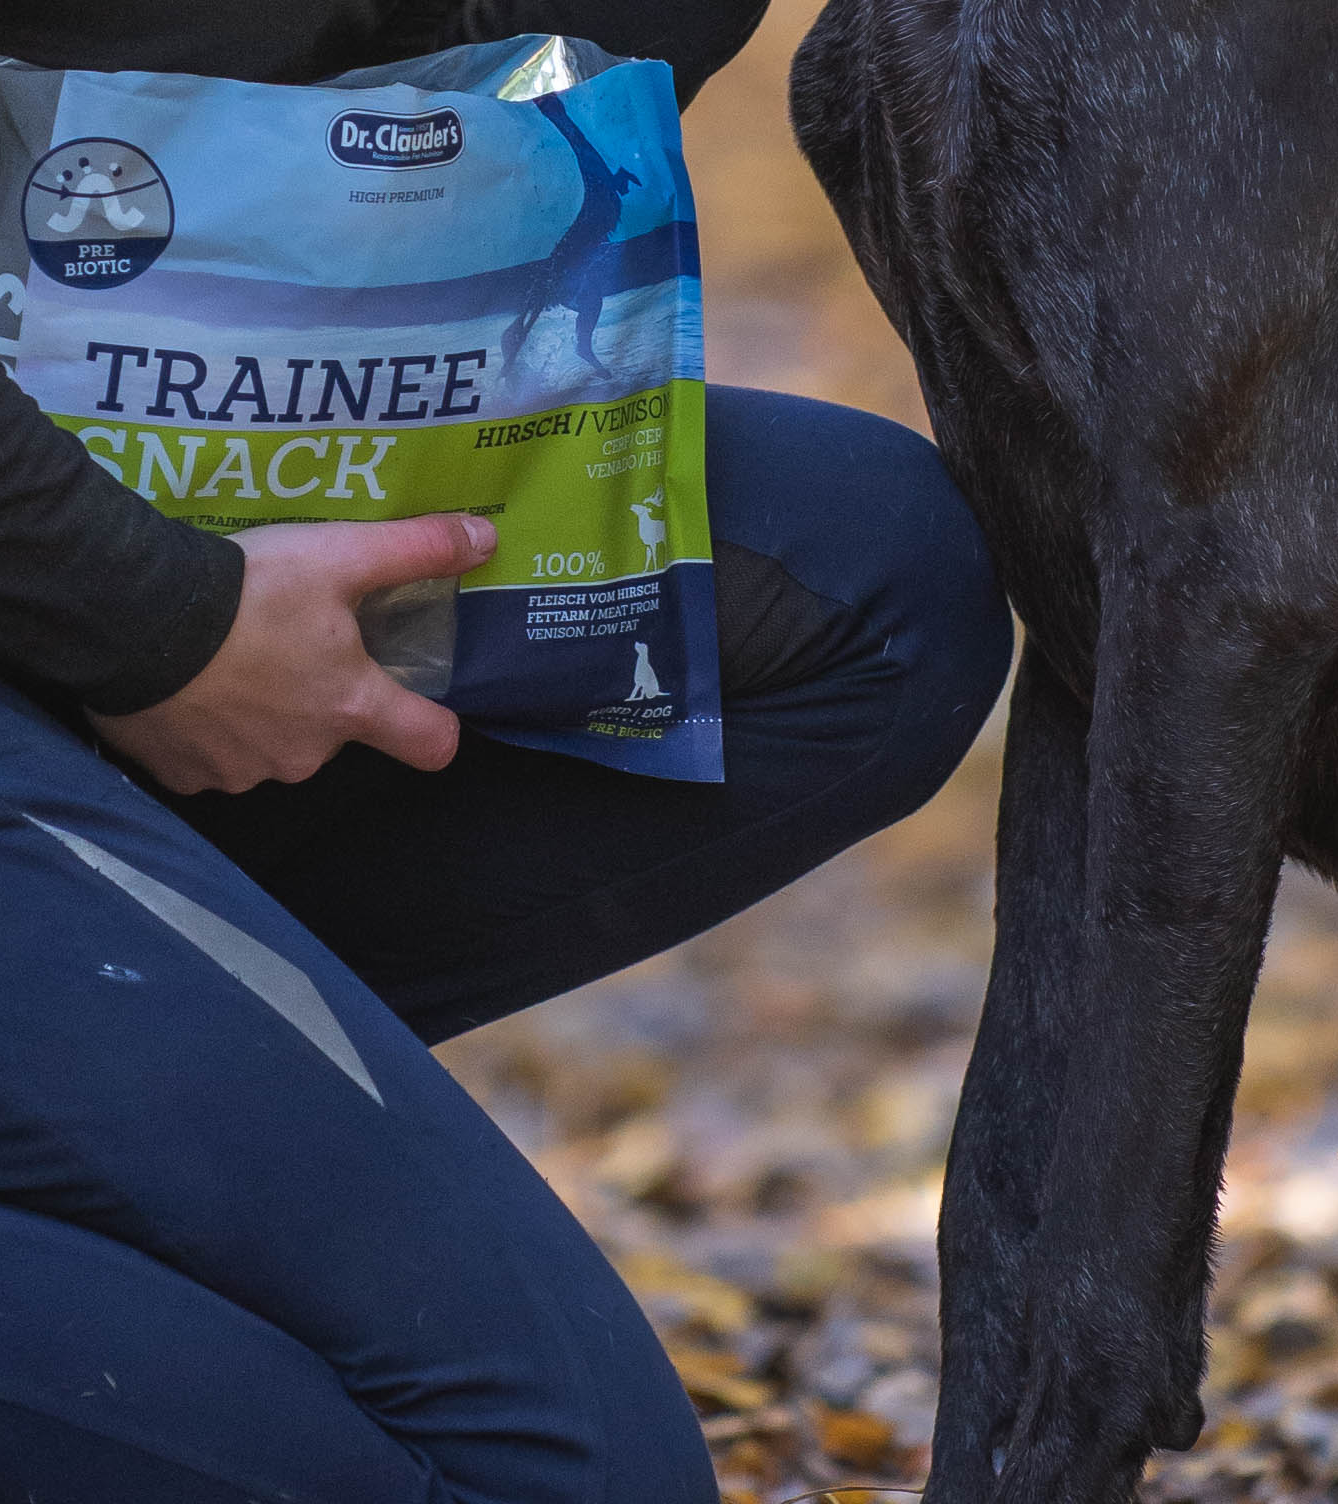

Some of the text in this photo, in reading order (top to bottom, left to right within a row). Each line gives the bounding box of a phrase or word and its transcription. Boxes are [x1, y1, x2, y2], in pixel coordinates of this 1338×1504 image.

[341, 119, 458, 152] Dr. Clauder's
[349, 187, 445, 204] HIGH PREMIUM
[78, 245, 115, 258] PRE
[65, 258, 131, 277] BIOTIC
[87, 341, 487, 423] TRAINEE
[475, 412, 572, 449] HIRSCH
[76, 426, 396, 500] SNACK
[531, 550, 606, 578] 100%
[528, 594, 586, 607] FLEISCH
[589, 591, 616, 604] VOM
[526, 610, 589, 624] FETTARM
[597, 605, 629, 620] MEAT
[630, 599, 660, 615] FROM
[590, 622, 619, 636] LOW
[619, 619, 640, 633] FAT
[641, 705, 673, 719] DOG
[587, 722, 662, 739] PRE BIOTIC
